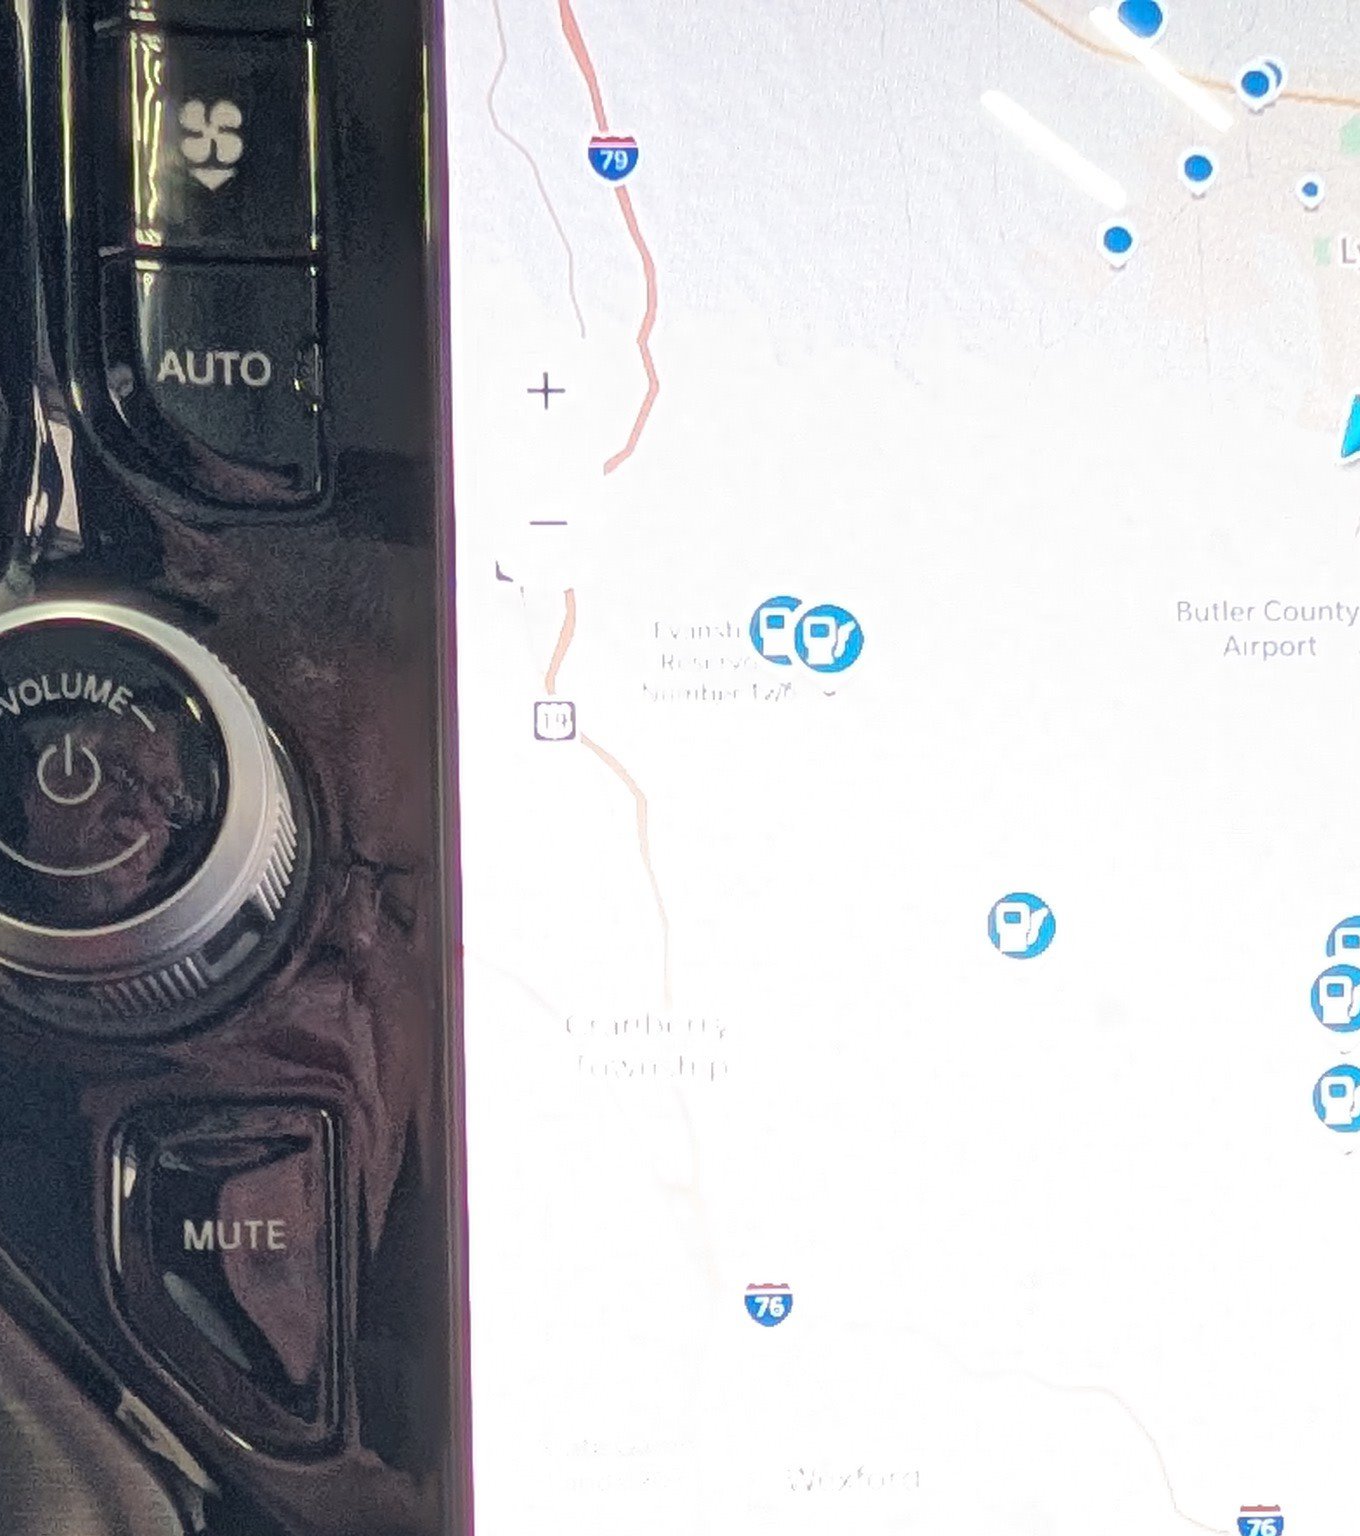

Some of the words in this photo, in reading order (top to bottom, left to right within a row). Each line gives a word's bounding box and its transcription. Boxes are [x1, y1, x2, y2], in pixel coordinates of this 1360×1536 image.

[600, 150, 629, 171] 79
[156, 350, 273, 388] AUTO
[1176, 600, 1254, 622] Butler
[1263, 600, 1360, 626] County
[1223, 635, 1317, 661] Airport
[183, 1219, 288, 1251] MUTE
[753, 1295, 786, 1319] 76
